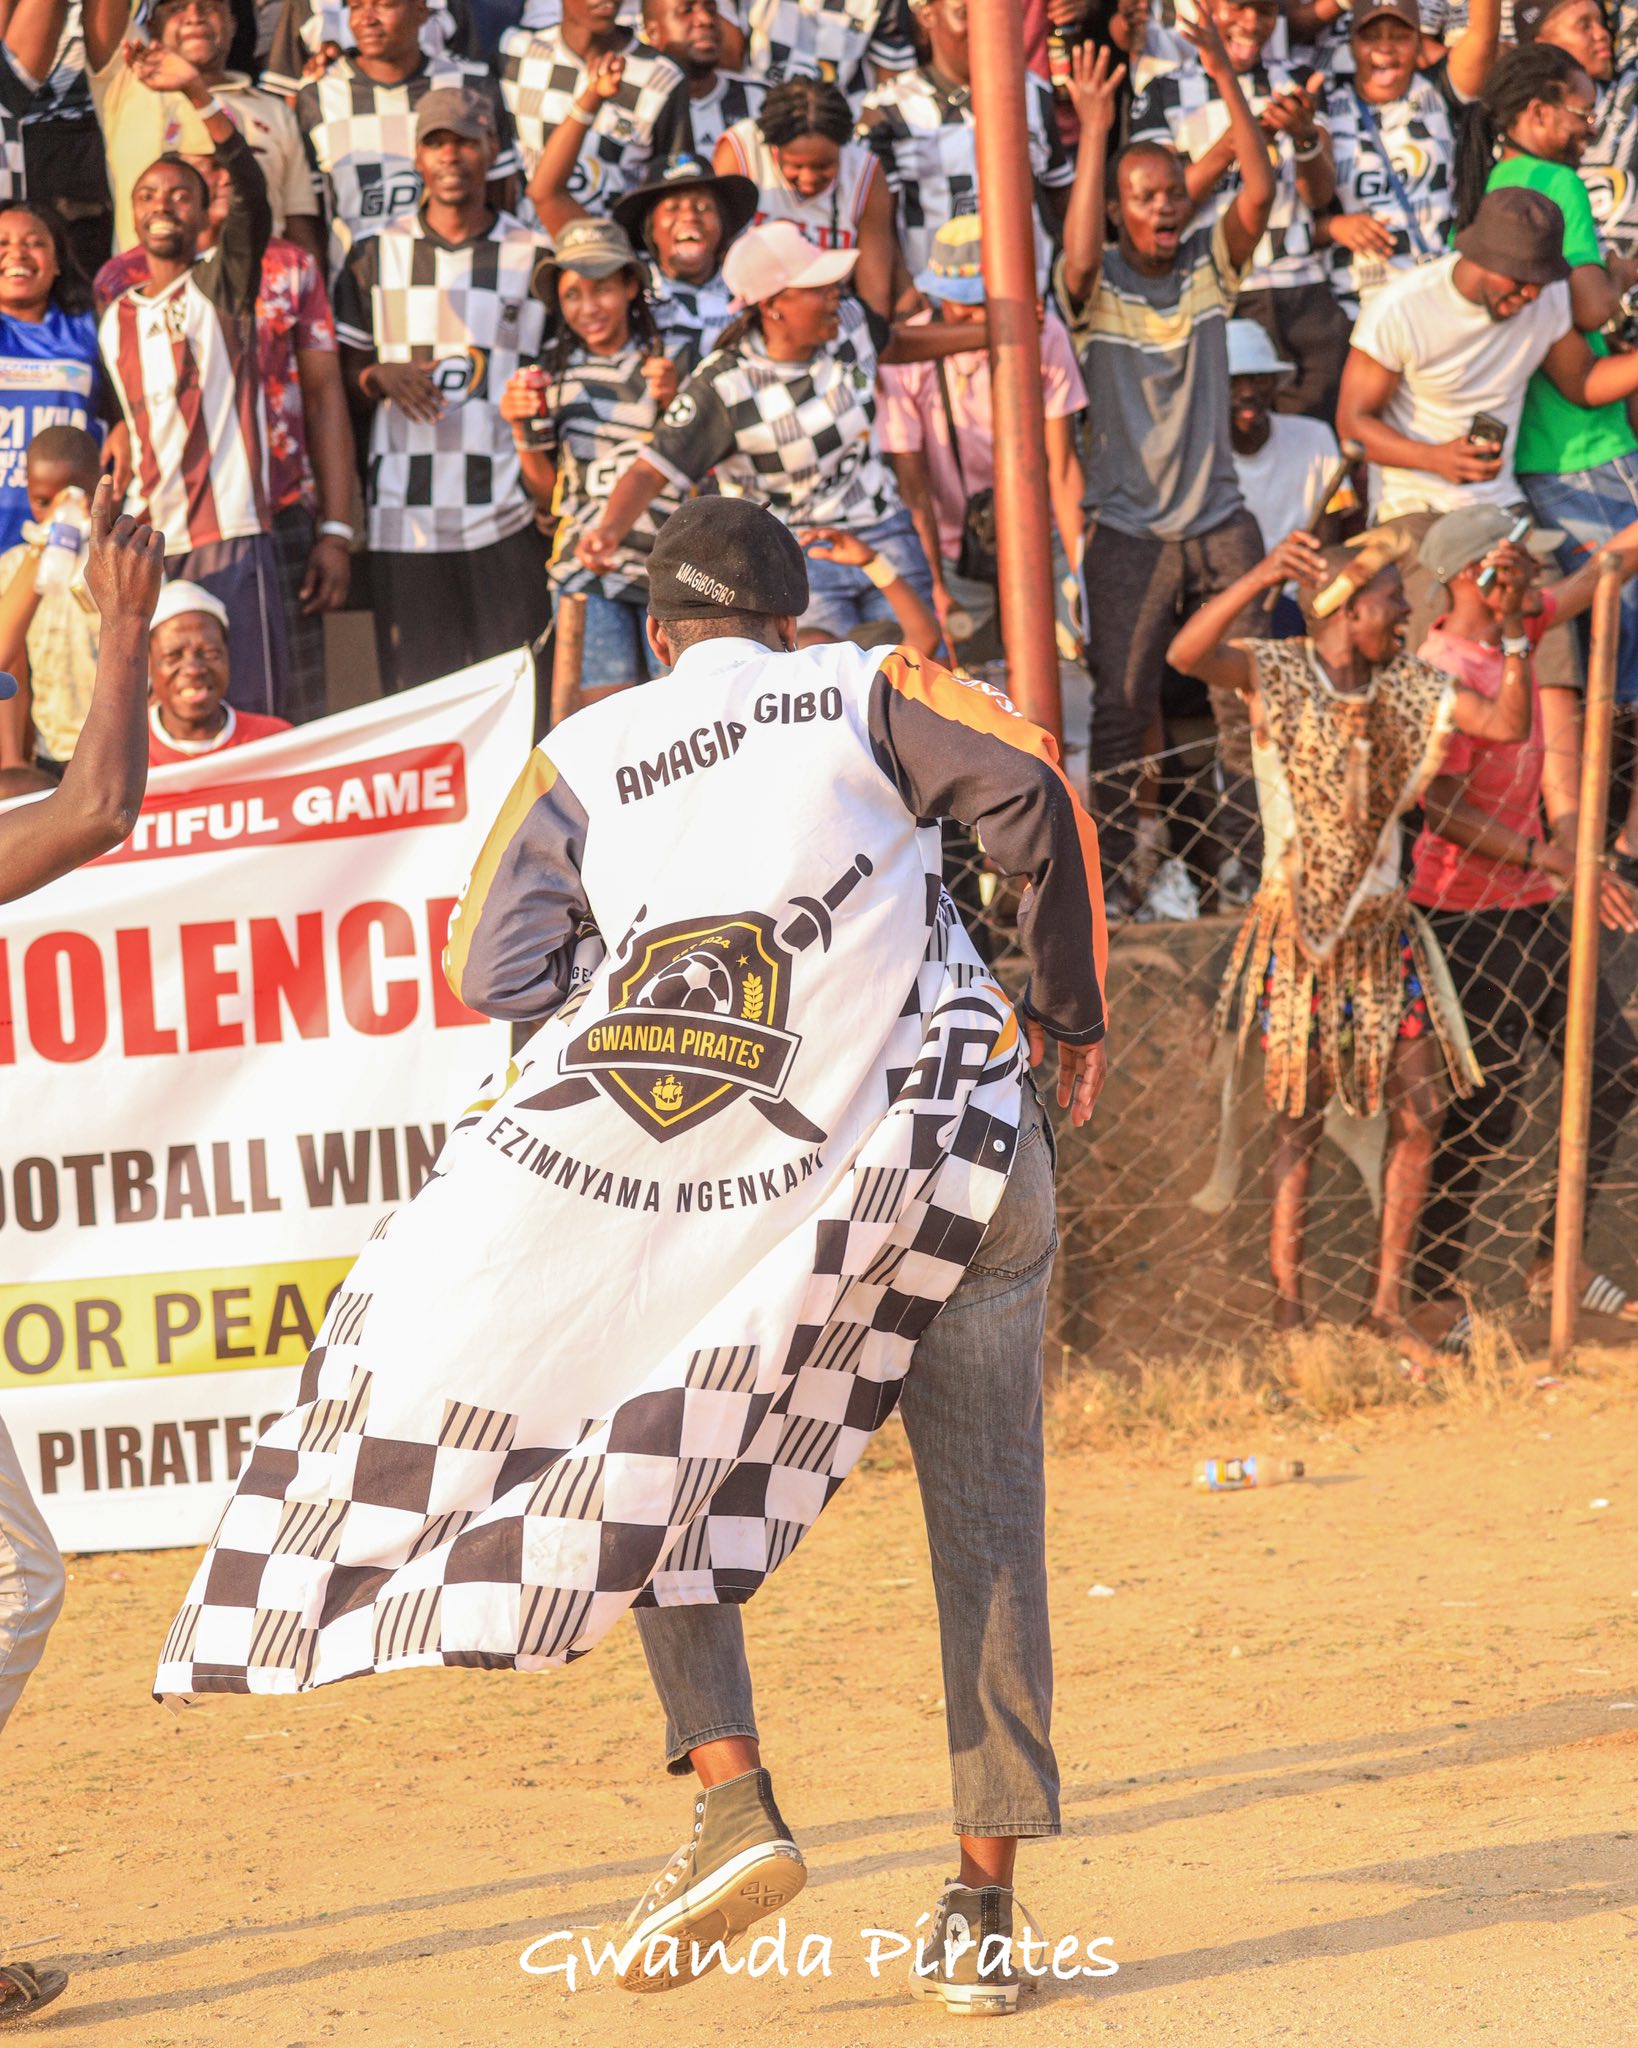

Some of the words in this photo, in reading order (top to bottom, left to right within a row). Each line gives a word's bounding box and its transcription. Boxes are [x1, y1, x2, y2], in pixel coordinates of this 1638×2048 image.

[675, 561, 736, 606] AMAGIBOGIBO
[107, 798, 280, 856] TIFUL
[292, 764, 457, 826] GAME
[587, 1024, 675, 1053] GWANDA
[680, 1029, 765, 1070] PIRATES
[0, 1137, 281, 1233] OTBALL
[485, 1116, 660, 1213] EZIMNYAMA
[3, 1297, 127, 1375] OR
[155, 1280, 345, 1364] PEA
[38, 1411, 284, 1495] PIRATE
